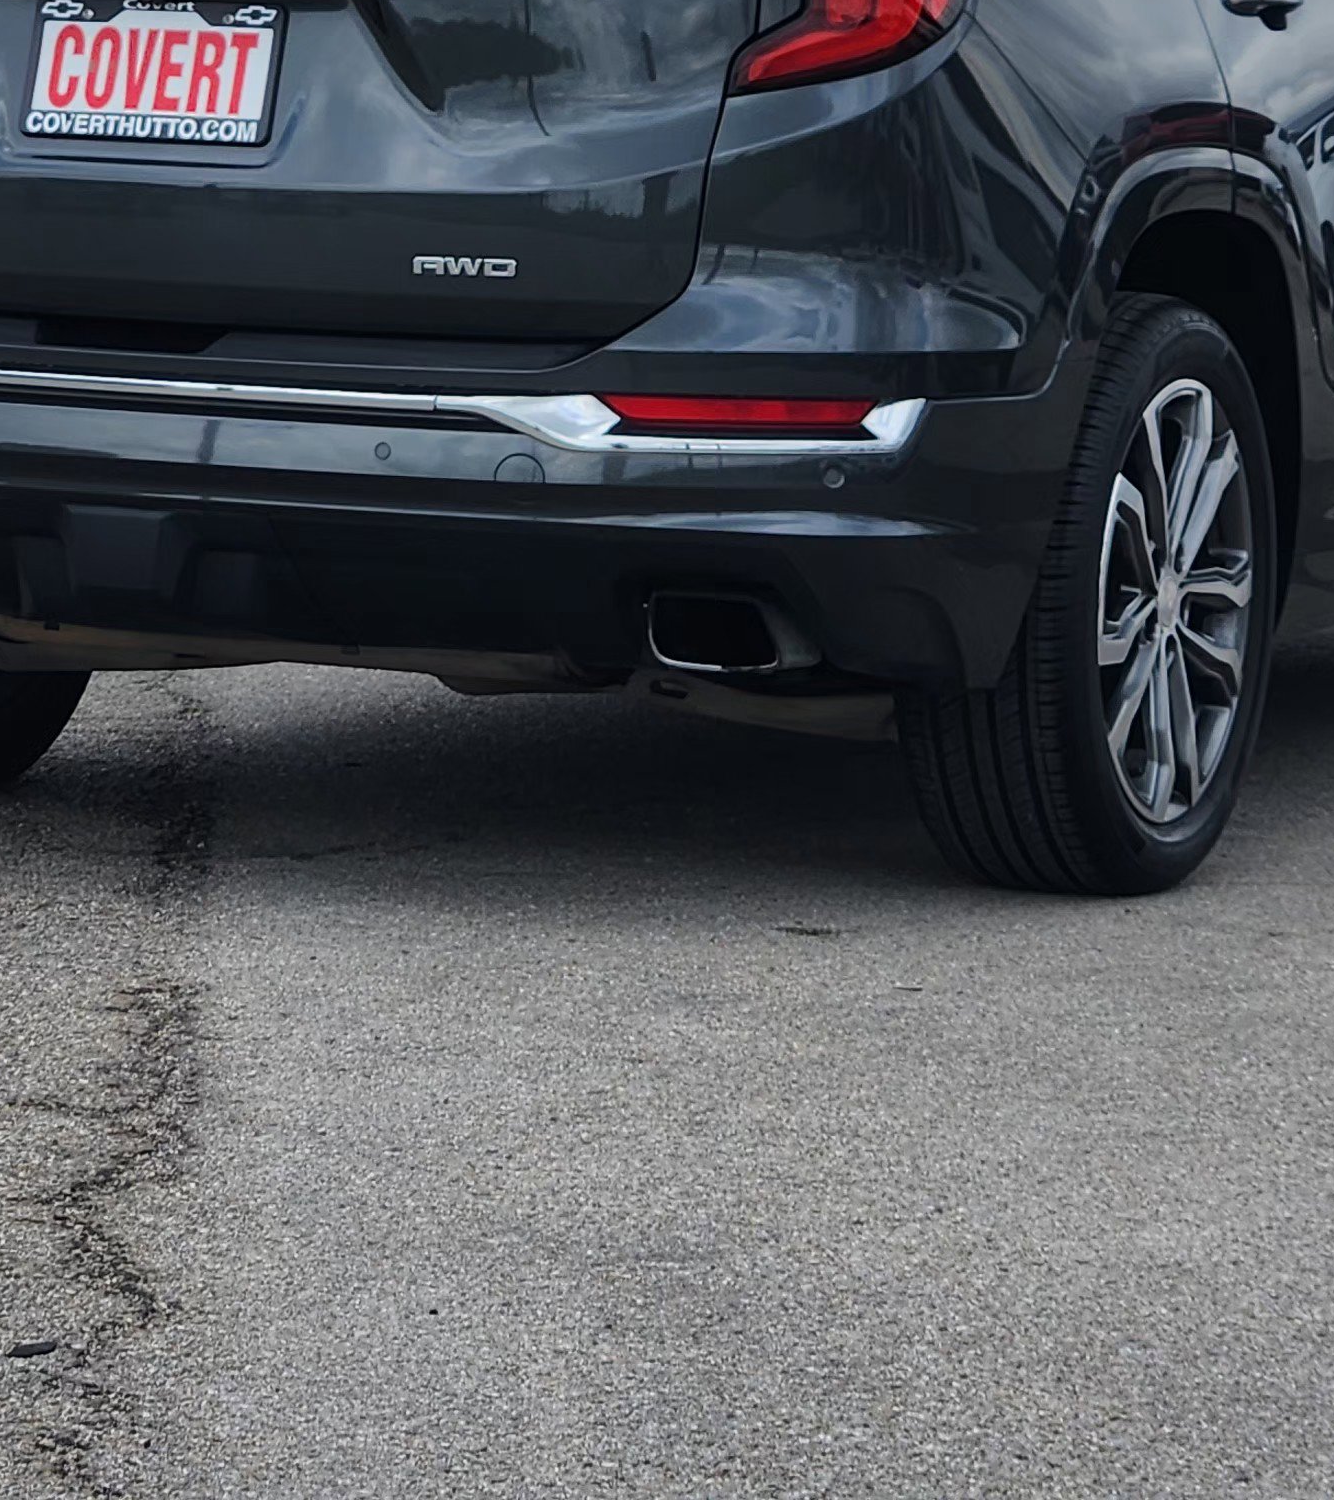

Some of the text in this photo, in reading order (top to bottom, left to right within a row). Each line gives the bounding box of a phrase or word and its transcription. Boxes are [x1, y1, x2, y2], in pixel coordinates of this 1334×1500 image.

[48, 24, 259, 115] COVERT
[26, 111, 258, 143] COVERTHUTTO.COM
[412, 256, 517, 277] AWD
